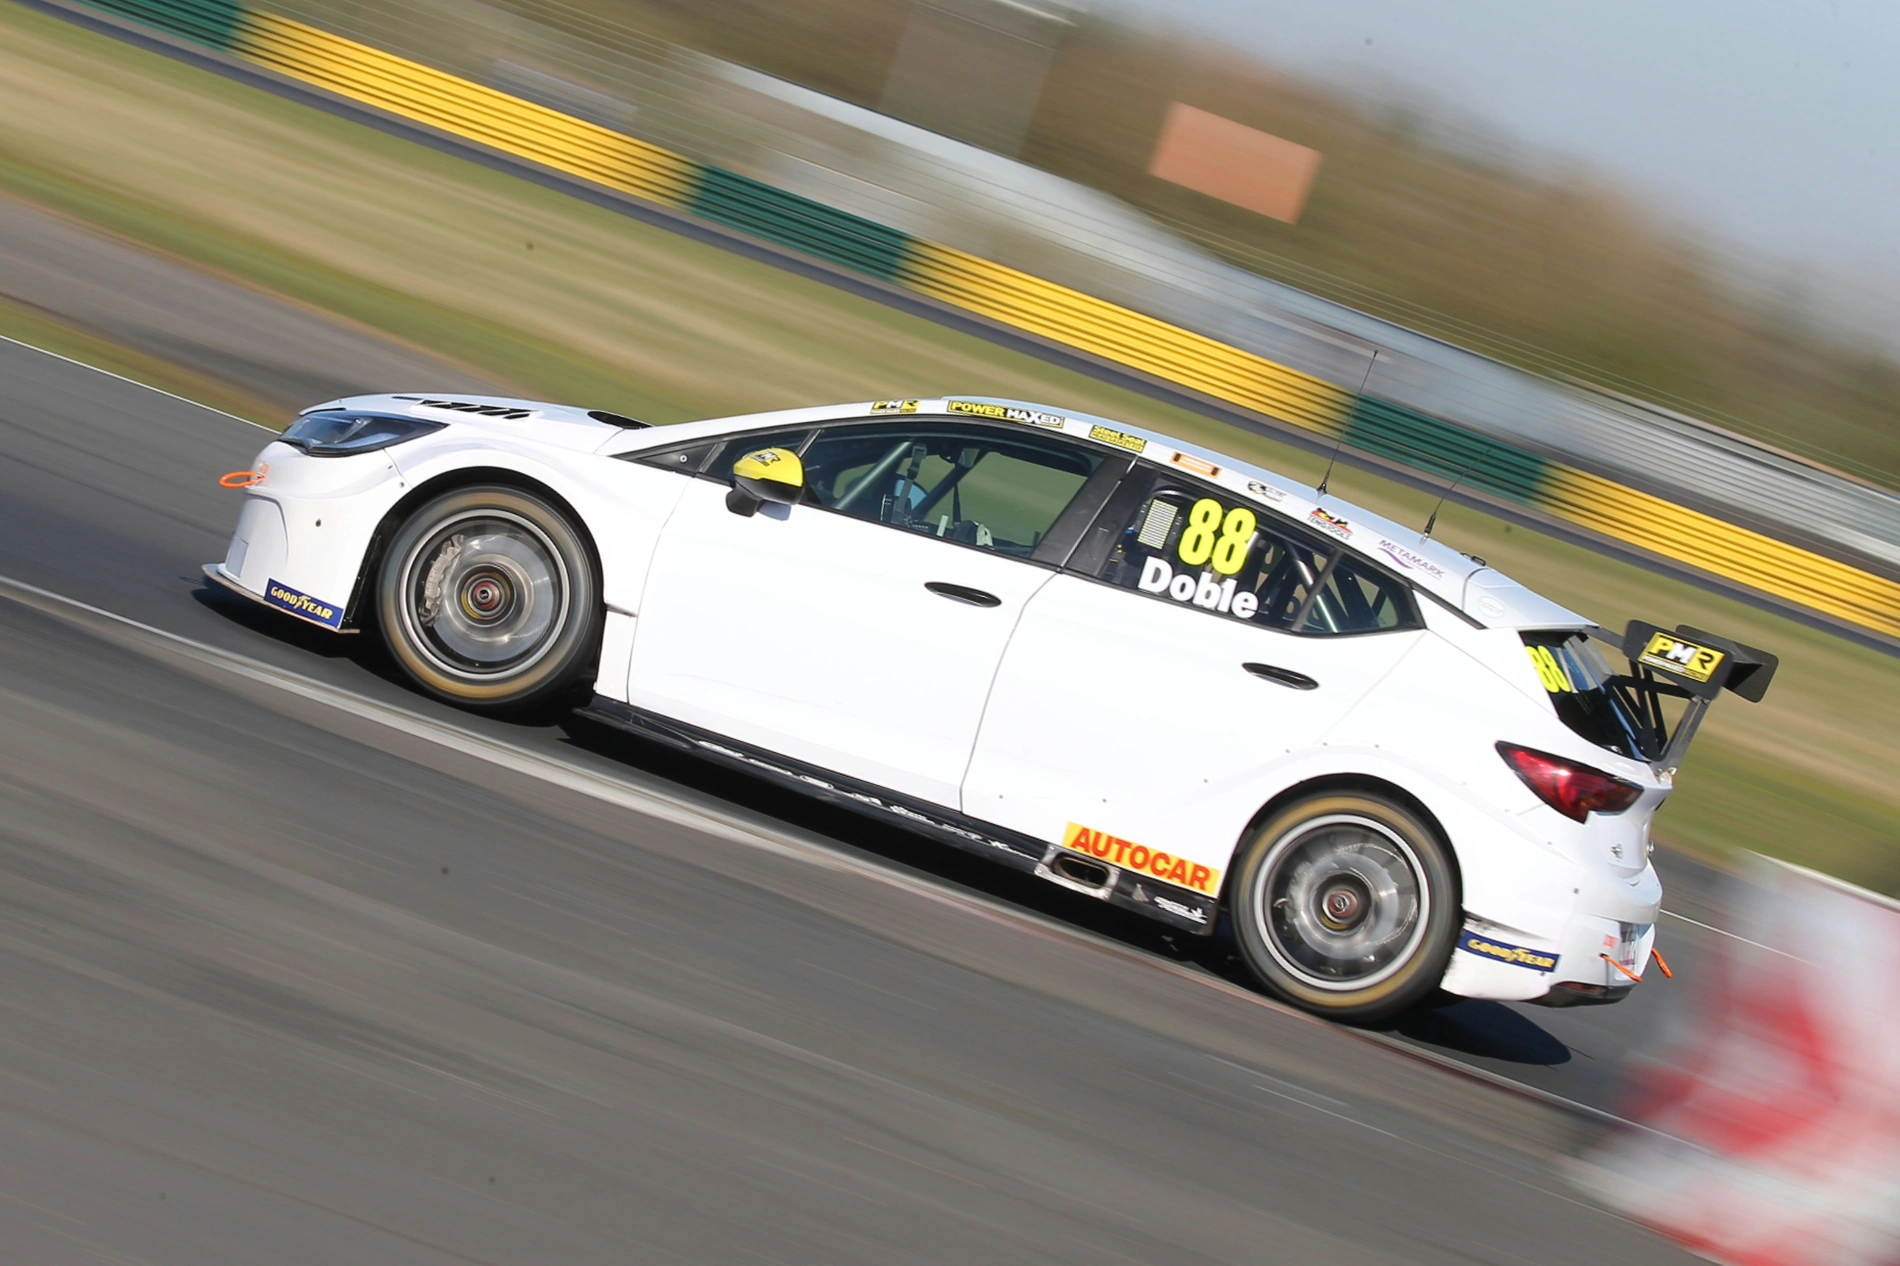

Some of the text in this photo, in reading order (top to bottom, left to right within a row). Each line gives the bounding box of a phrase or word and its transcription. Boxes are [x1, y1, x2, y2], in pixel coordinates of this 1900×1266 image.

[952, 402, 1062, 425] POWER MAXED
[1179, 498, 1257, 575] 88
[1378, 539, 1446, 578] METAMARK
[270, 586, 334, 620] GOODYEAR
[1138, 555, 1259, 619] Doble
[1525, 645, 1571, 693] 88
[1648, 639, 1715, 669] PMR
[1071, 827, 1211, 891] AUTOCAR
[1467, 938, 1555, 968] GOODYEAR
